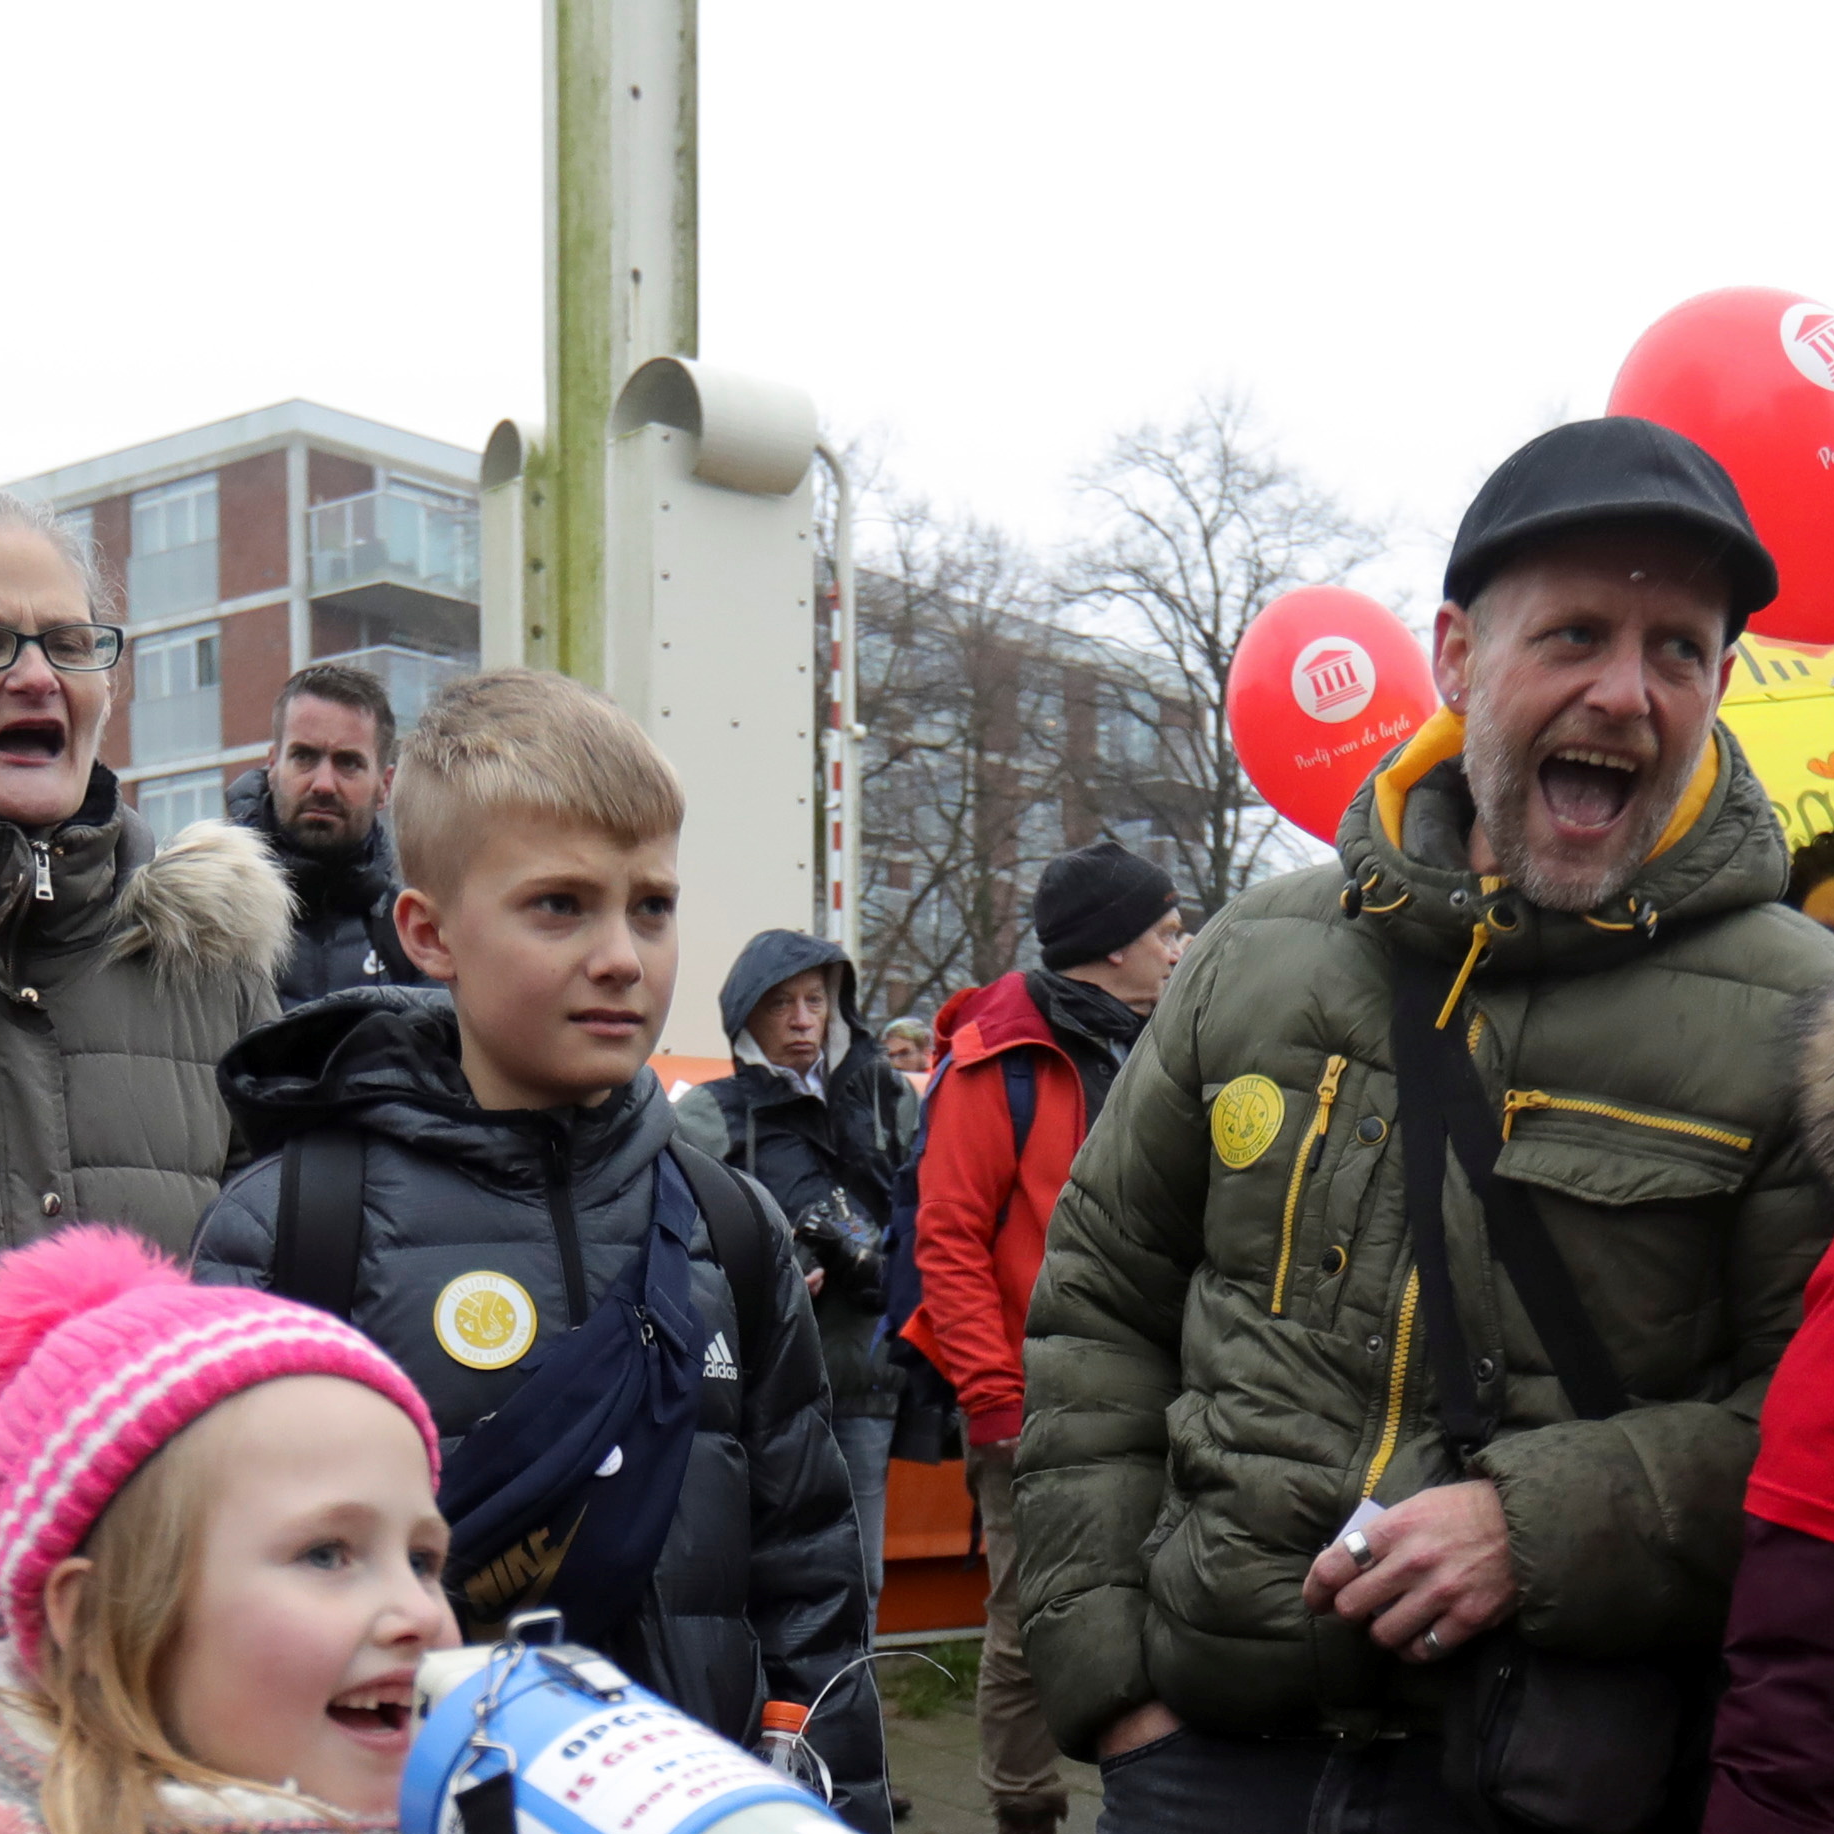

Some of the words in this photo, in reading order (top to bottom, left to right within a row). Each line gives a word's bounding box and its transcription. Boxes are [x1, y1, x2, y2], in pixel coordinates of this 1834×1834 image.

[1294, 748, 1332, 770] Partij
[1333, 741, 1359, 757] van
[1361, 727, 1378, 746] de
[1379, 714, 1410, 740] liefde
[463, 1527, 551, 1607] NIKE
[564, 1773, 596, 1803] IS
